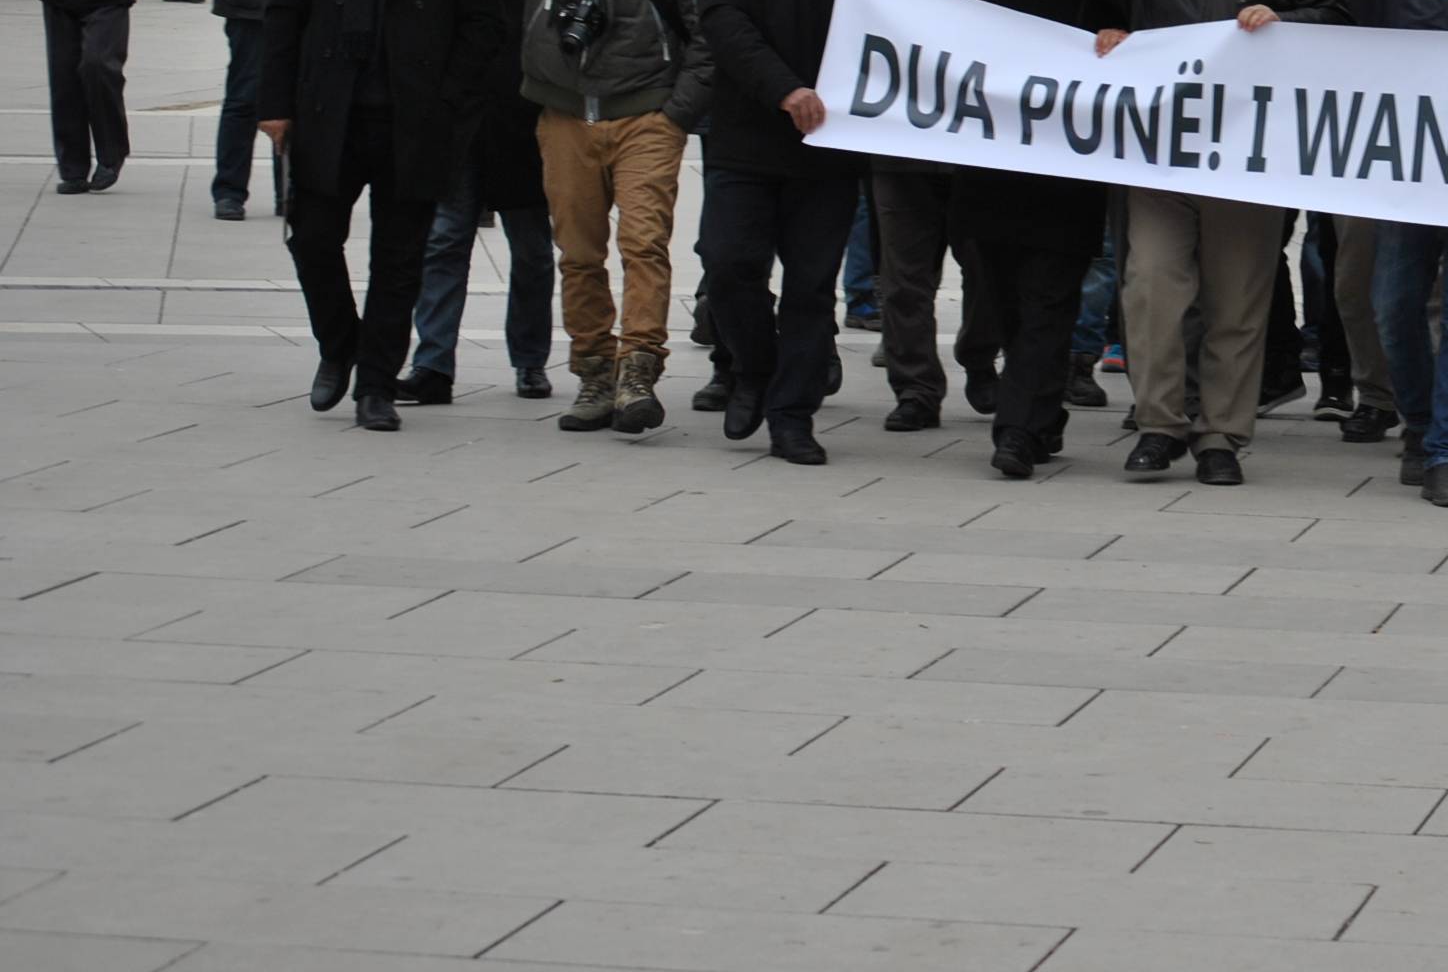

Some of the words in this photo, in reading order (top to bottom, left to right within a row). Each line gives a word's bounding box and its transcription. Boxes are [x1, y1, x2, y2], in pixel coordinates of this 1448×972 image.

[849, 33, 996, 141] DUA
[1019, 59, 1227, 172] PUNË!
[1245, 86, 1273, 174] I
